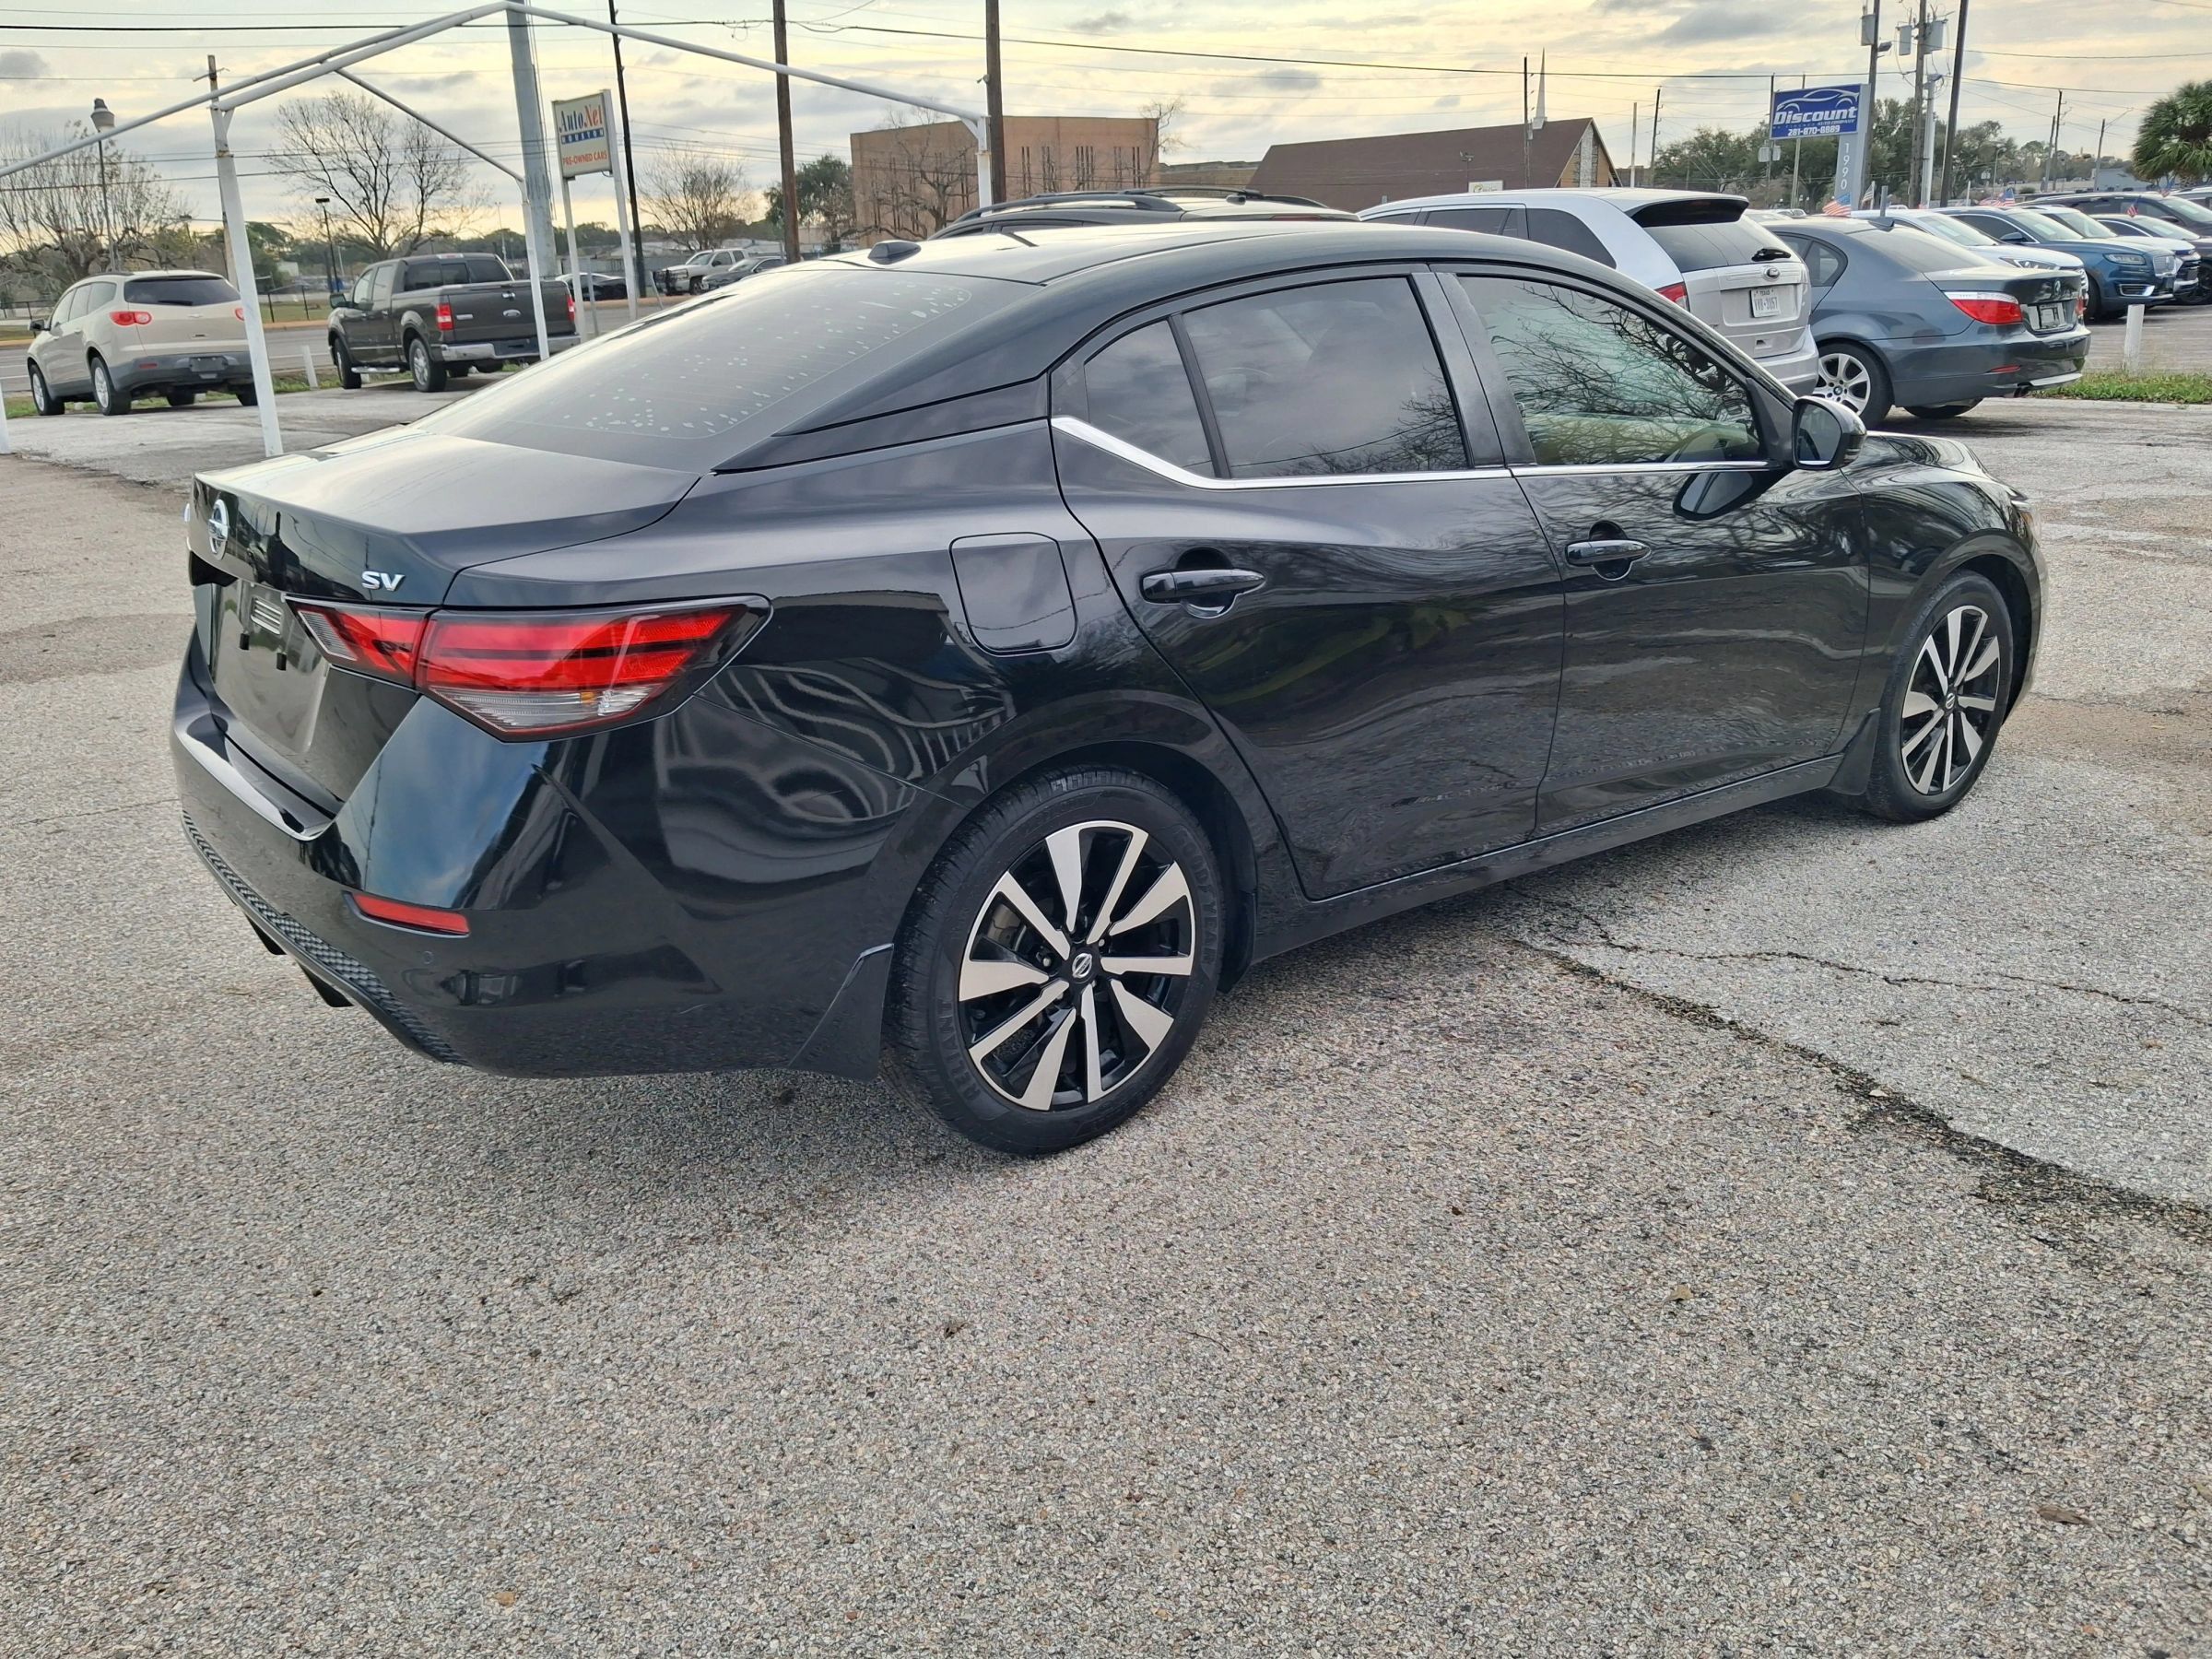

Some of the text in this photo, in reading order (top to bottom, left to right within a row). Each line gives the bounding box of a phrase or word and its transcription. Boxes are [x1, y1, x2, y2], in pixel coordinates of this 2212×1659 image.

[1773, 106, 1858, 125] Discount
[562, 130, 605, 143] HOUSTON
[562, 150, 607, 166] PRE-OWNED CARS
[1841, 142, 1851, 190] 1990
[361, 571, 406, 592] SV
